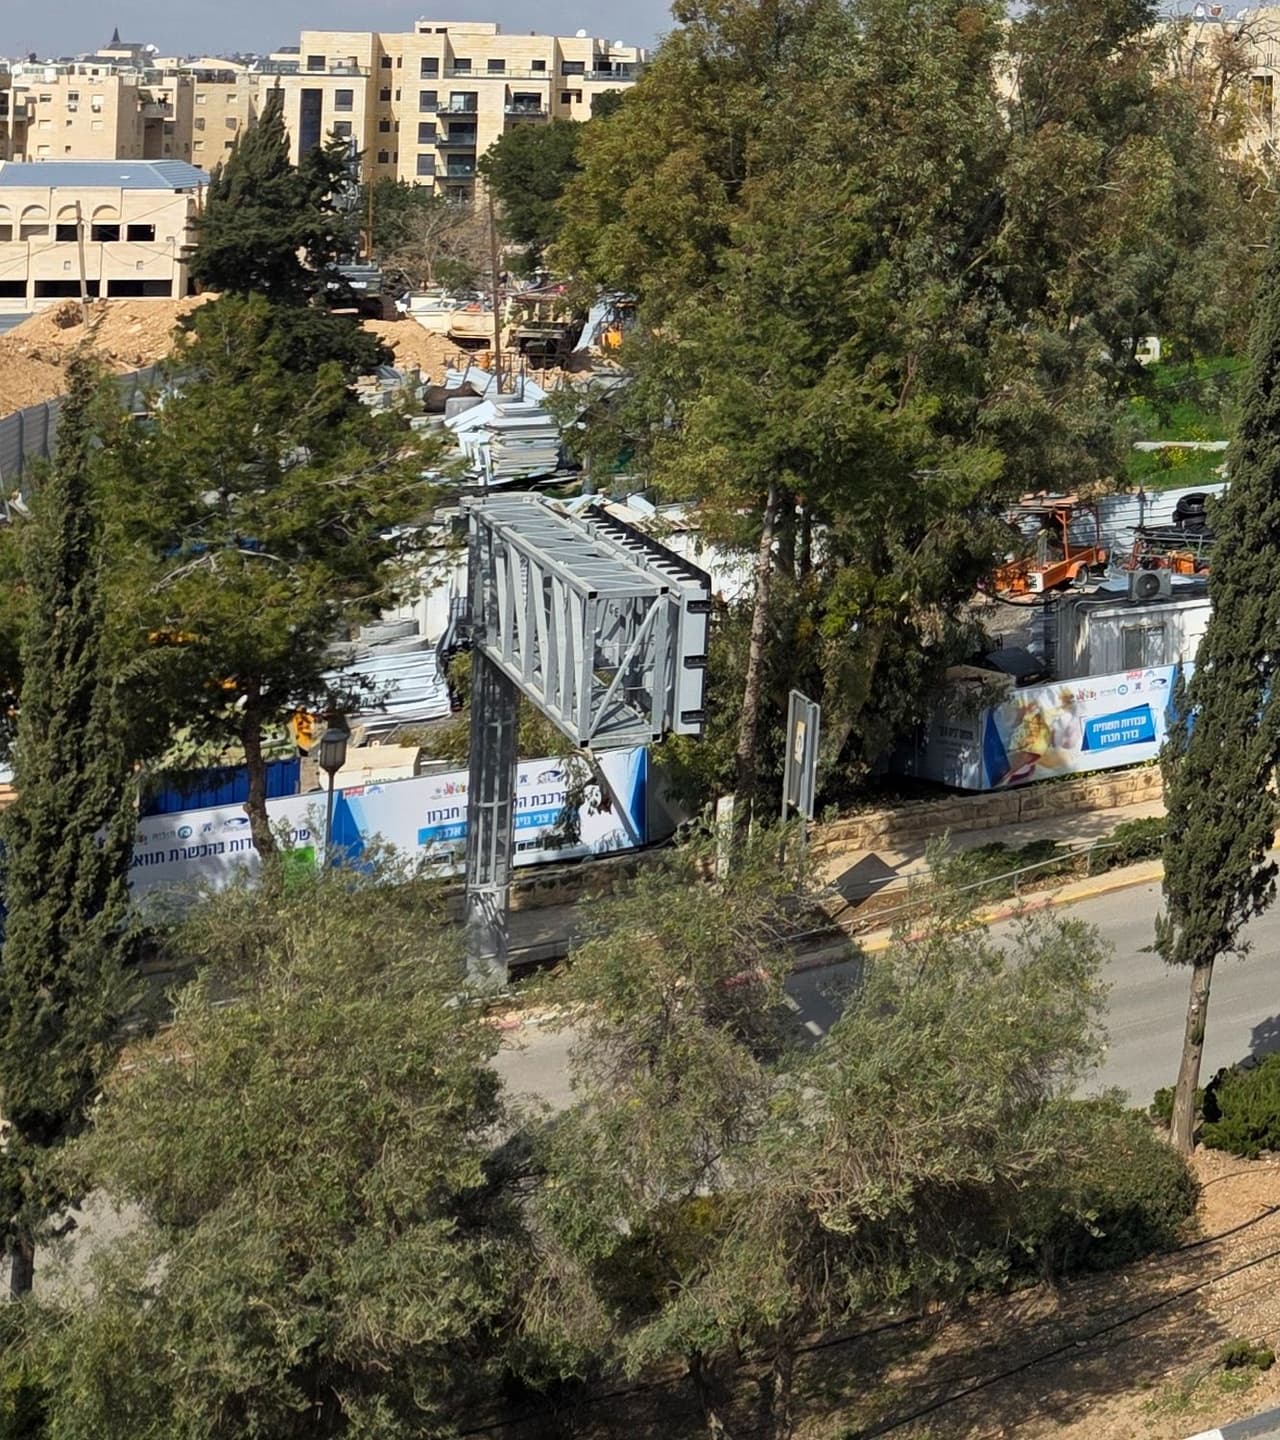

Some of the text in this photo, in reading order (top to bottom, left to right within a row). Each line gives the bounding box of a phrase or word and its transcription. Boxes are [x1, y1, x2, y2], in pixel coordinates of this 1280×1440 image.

[1100, 732, 1121, 746] חברון
[427, 806, 460, 825] חברון
[169, 842, 225, 861] בהכשרת
